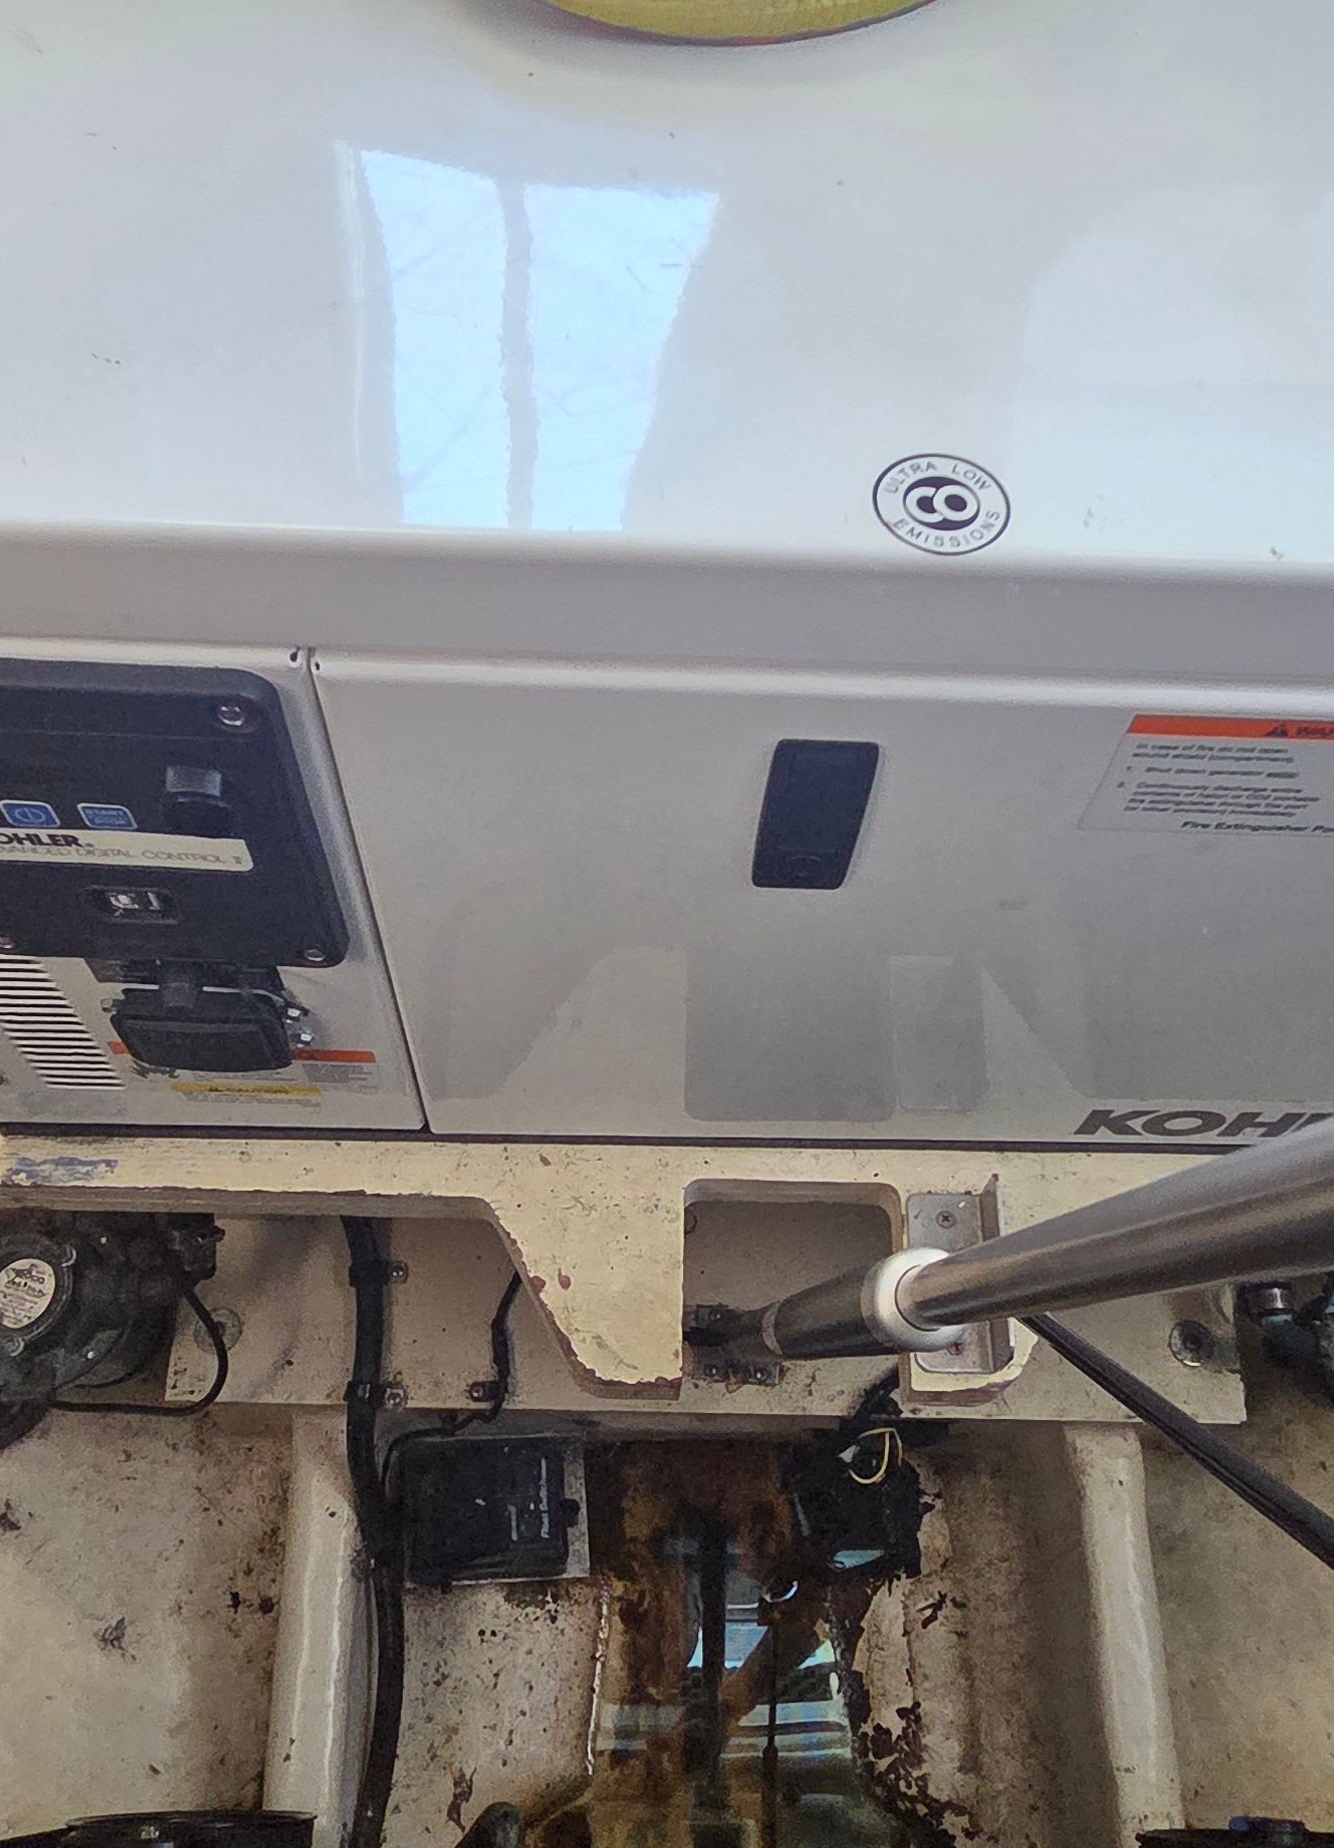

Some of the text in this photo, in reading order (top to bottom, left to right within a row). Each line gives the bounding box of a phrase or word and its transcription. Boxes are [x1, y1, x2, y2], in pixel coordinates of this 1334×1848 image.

[884, 461, 991, 494] ULTRA LOW
[893, 511, 999, 547] EMISSIONS
[1181, 821, 1211, 829] Fire
[1214, 822, 1308, 832] Extinguisher
[76, 849, 134, 859] DIGITAL
[141, 850, 226, 864] CONTROL
